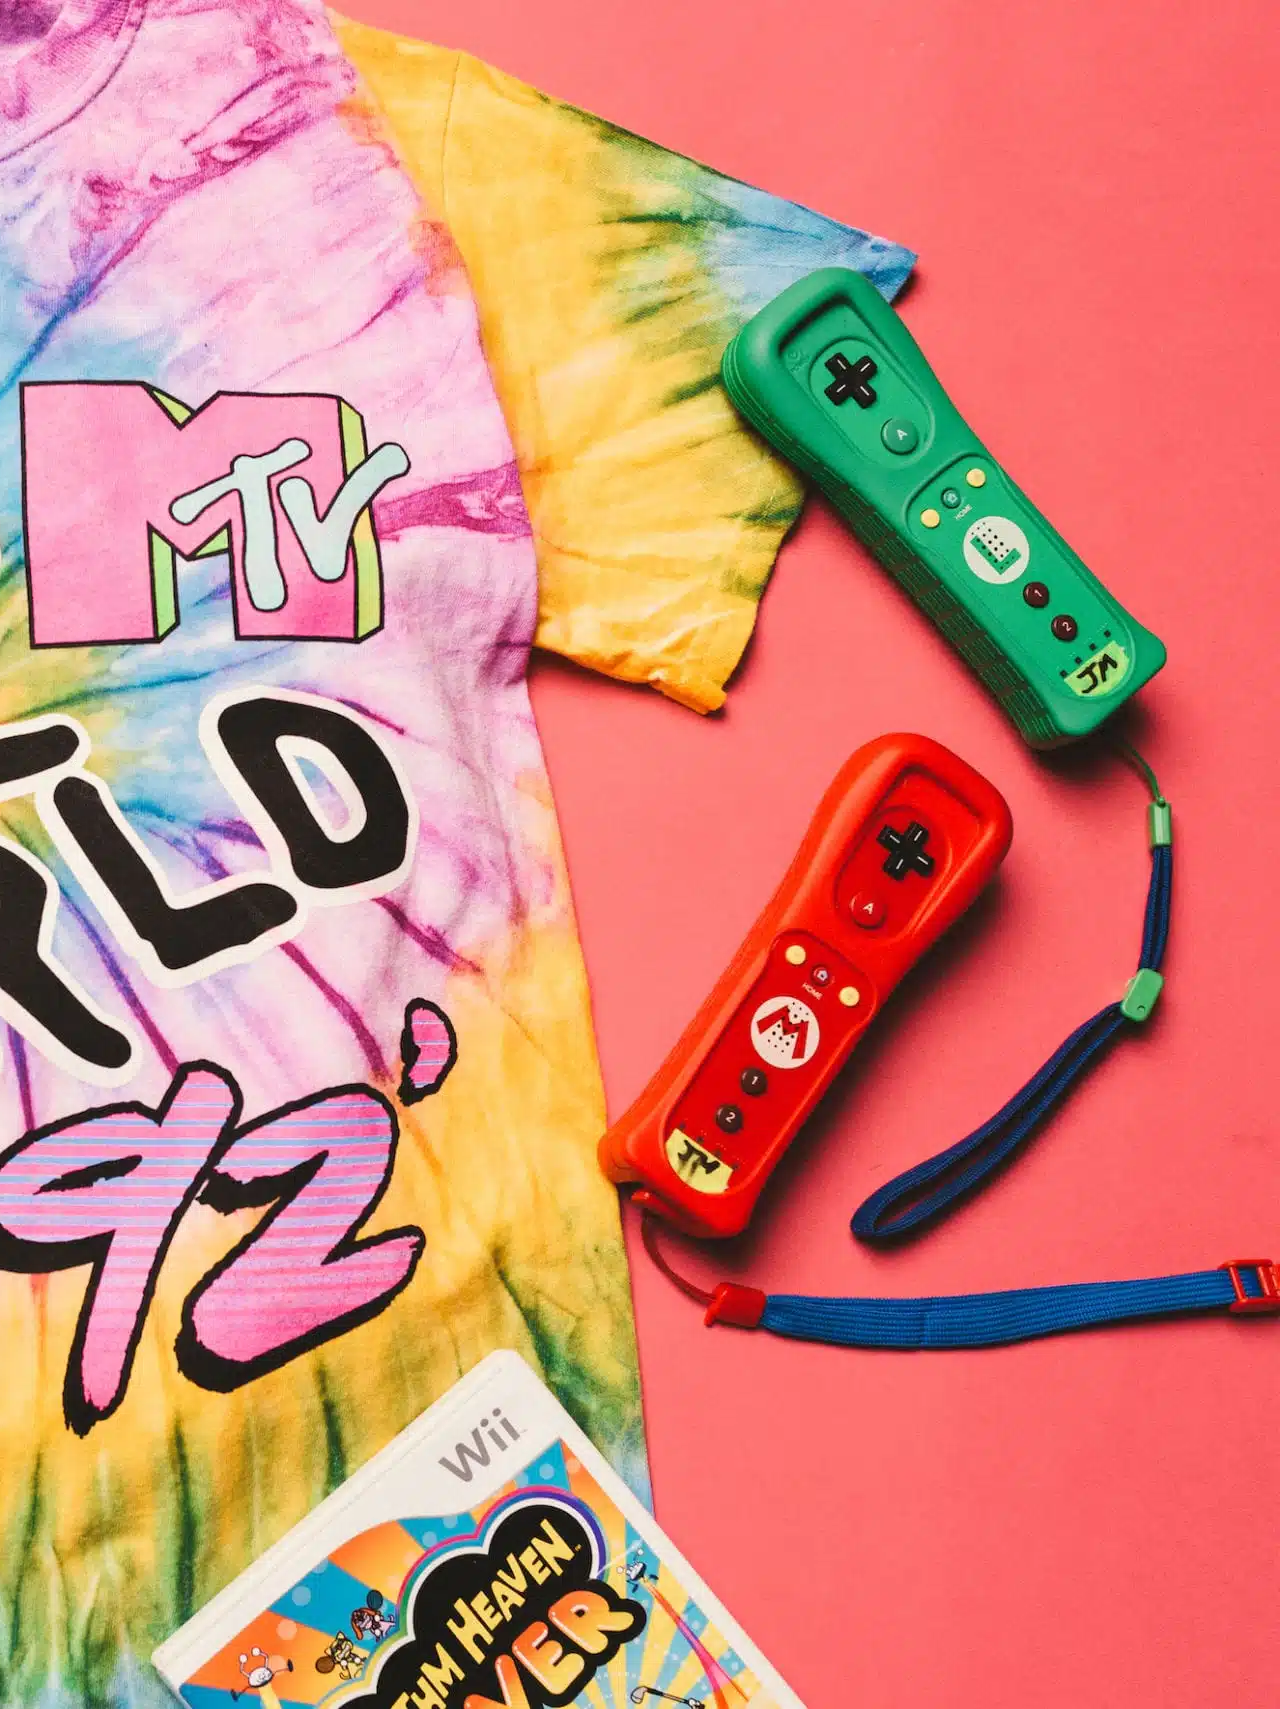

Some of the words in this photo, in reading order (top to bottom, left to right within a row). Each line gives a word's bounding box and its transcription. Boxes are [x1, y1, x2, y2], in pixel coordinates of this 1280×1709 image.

[895, 428, 909, 442] A
[19, 380, 411, 649] MTV
[954, 503, 973, 521] HOME
[1061, 621, 1073, 632] 2
[1076, 652, 1119, 695] JM
[862, 901, 875, 915] A
[801, 981, 824, 1001] HOME
[756, 1004, 810, 1060] M
[725, 1111, 736, 1123] 2
[437, 1407, 521, 1482] Wii
[446, 1518, 575, 1665] HEAVEN
